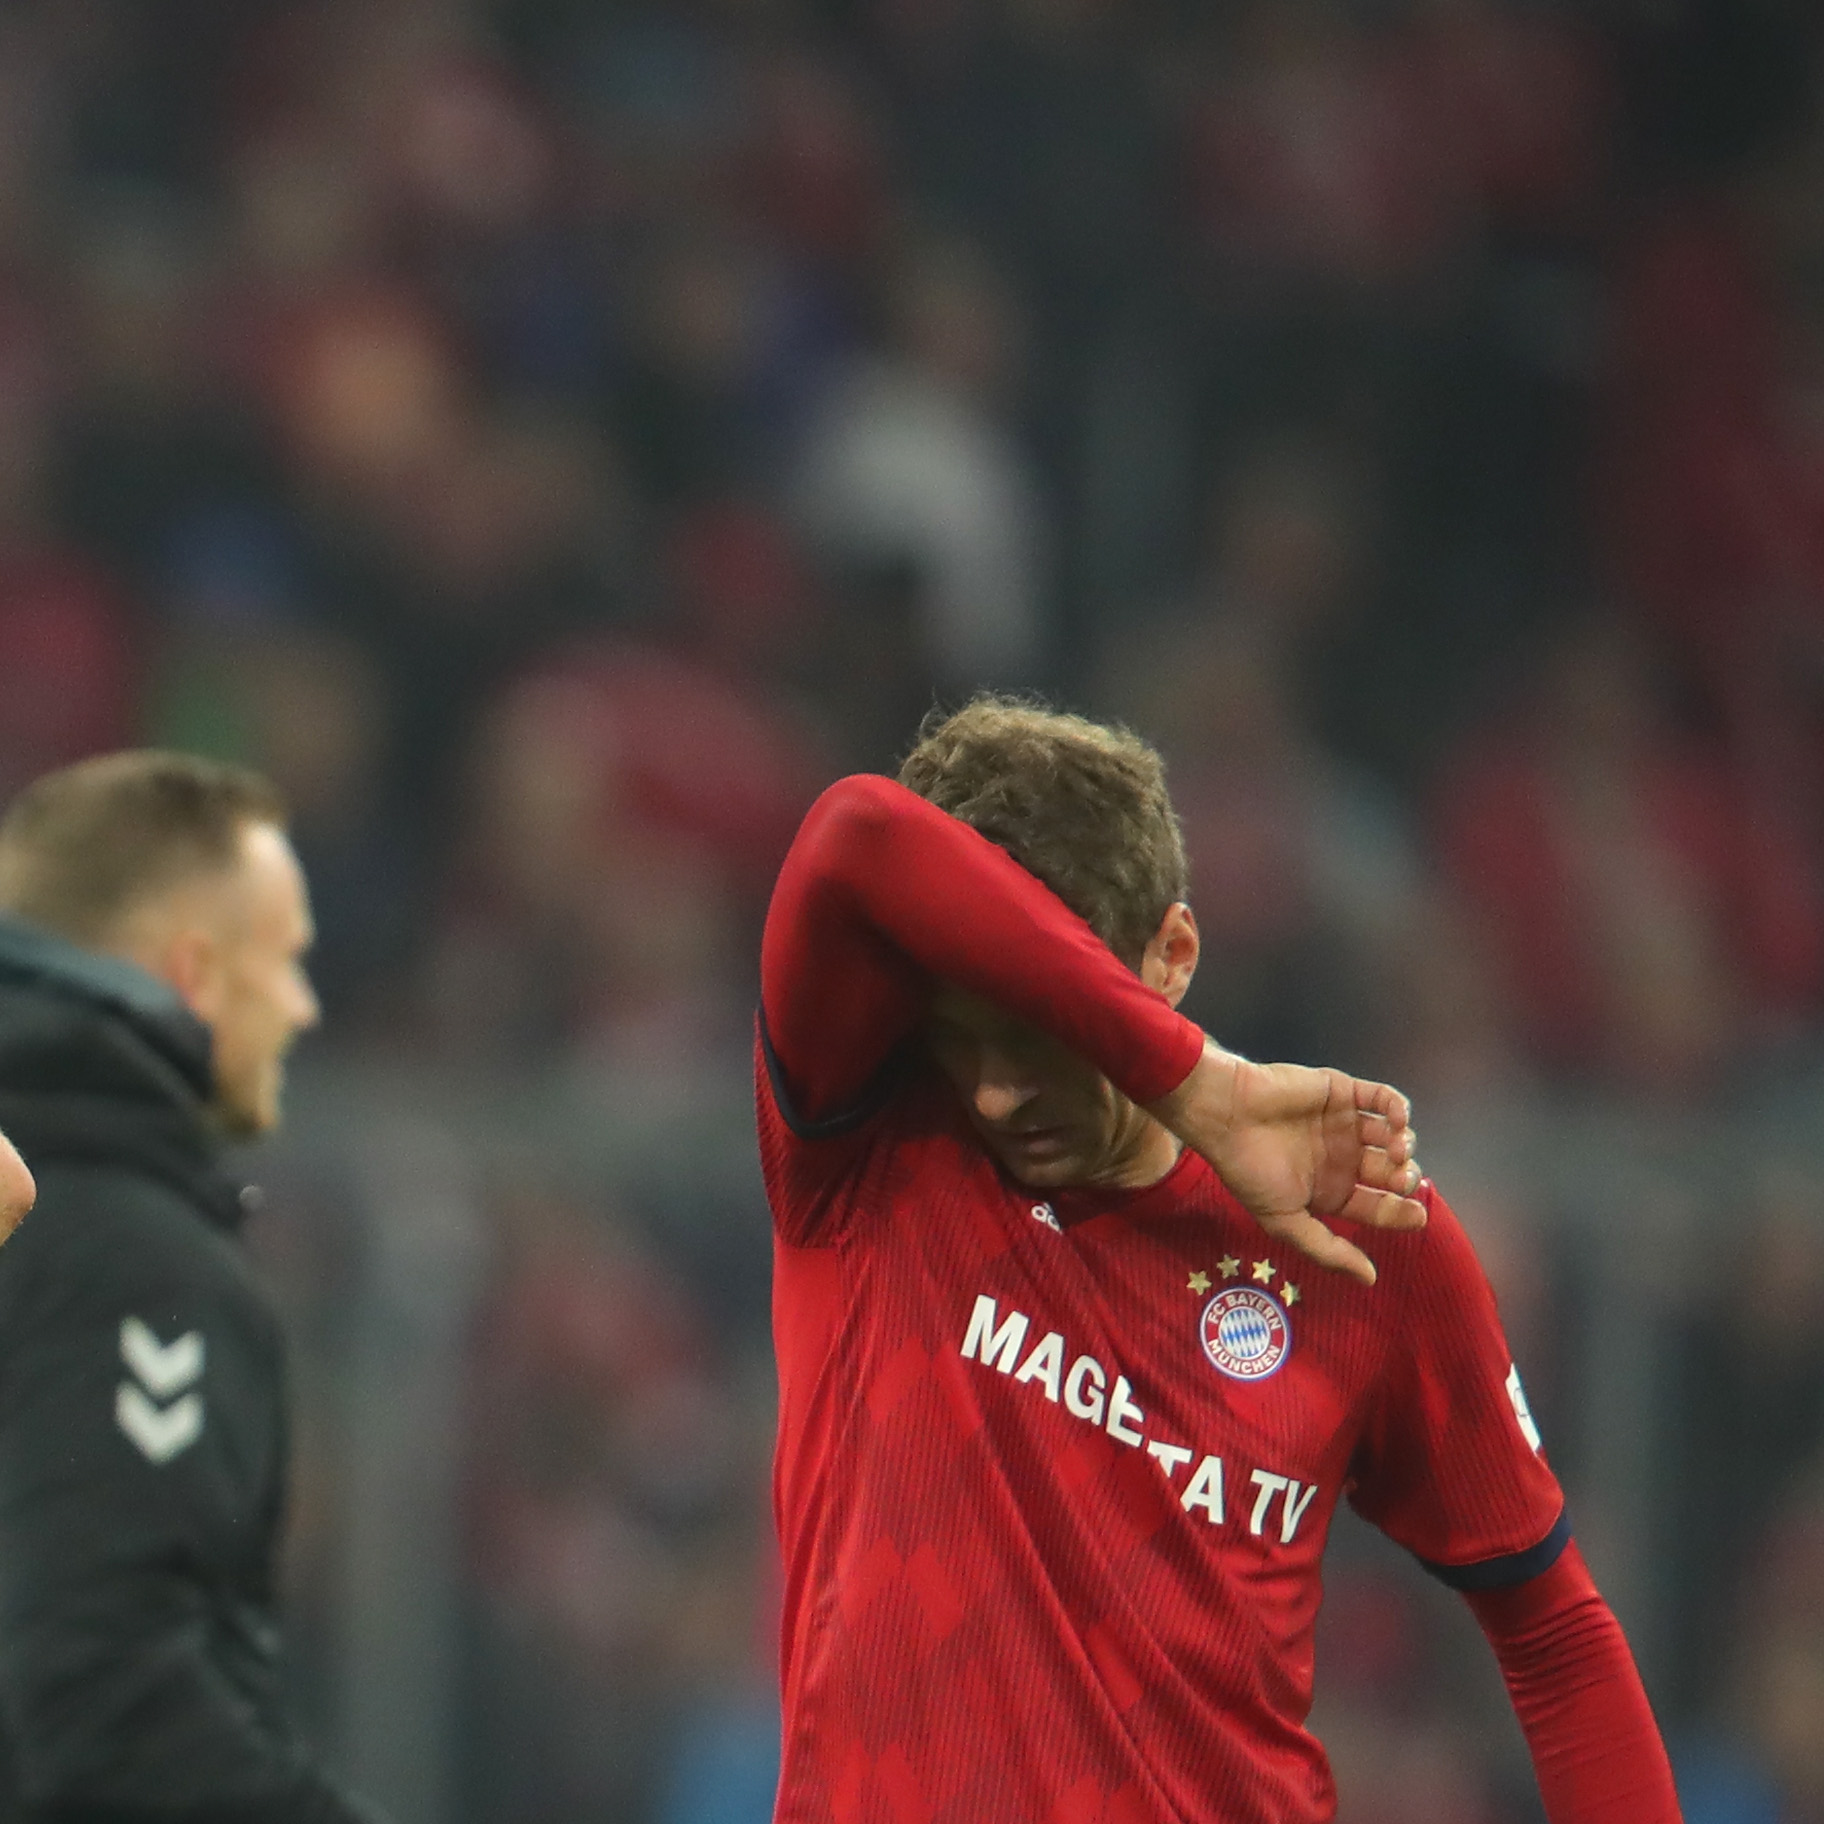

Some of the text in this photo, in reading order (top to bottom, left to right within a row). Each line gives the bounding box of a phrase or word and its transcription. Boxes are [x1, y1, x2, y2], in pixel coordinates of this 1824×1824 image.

[1207, 1292, 1282, 1331] FC BAYERN
[960, 1294, 1319, 1544] MAGETA TV
